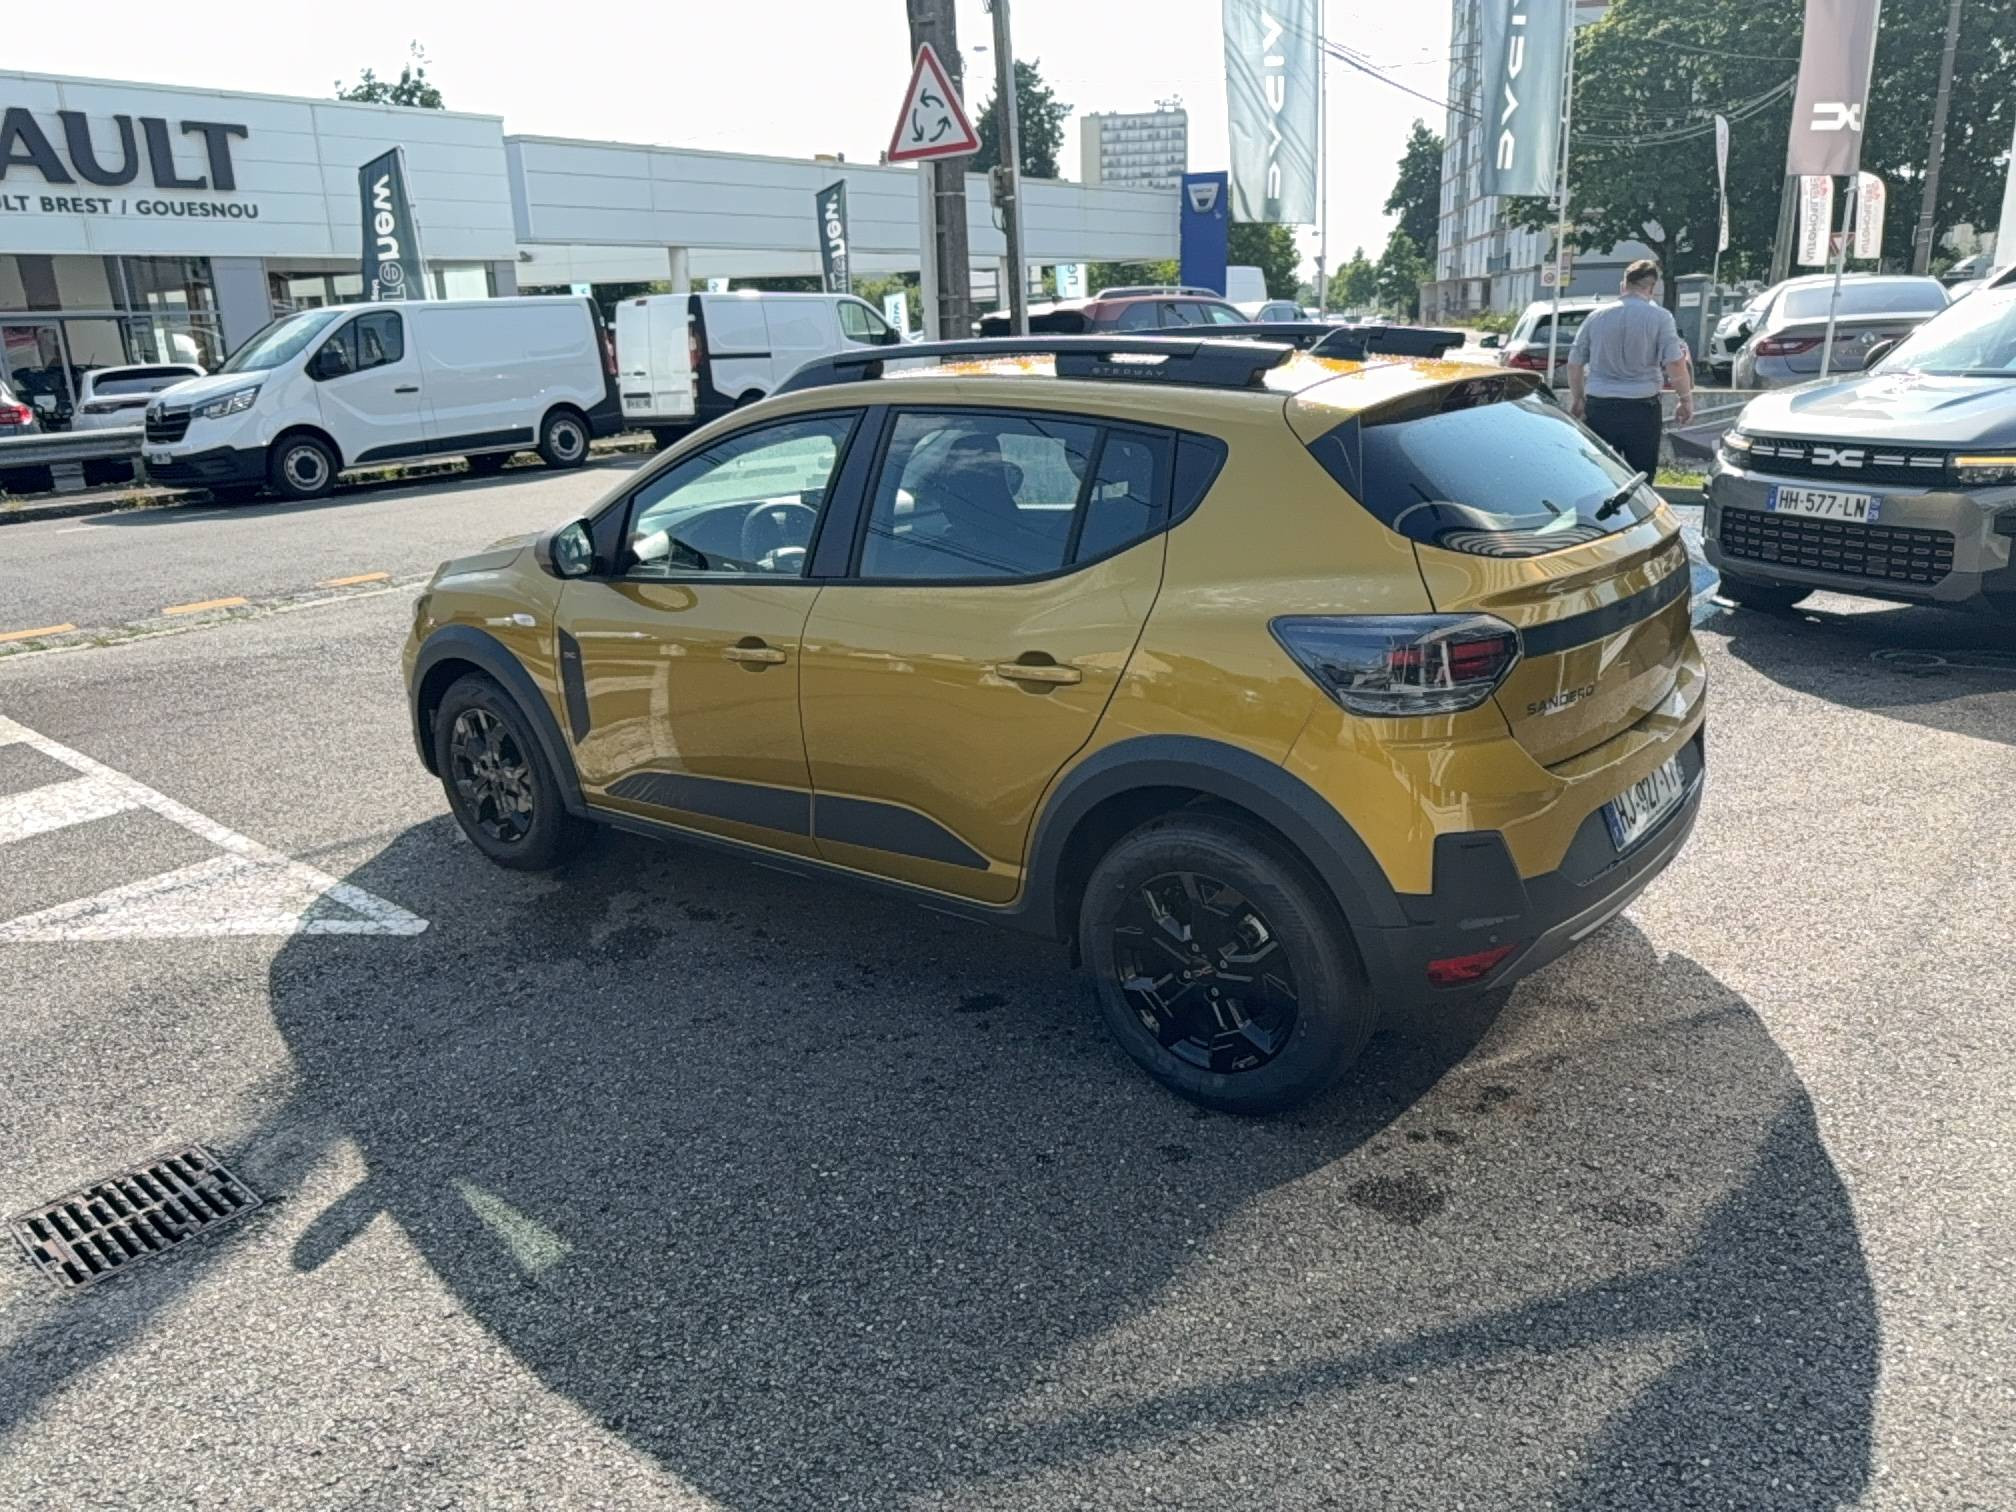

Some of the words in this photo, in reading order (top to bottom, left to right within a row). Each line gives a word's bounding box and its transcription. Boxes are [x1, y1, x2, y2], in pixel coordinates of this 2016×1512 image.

[0, 195, 30, 212] LT
[40, 196, 112, 214] BREST
[135, 200, 259, 219] GOUESNOU
[1779, 489, 1867, 519] HH-577-LN
[1527, 685, 1594, 716] SANDERO
